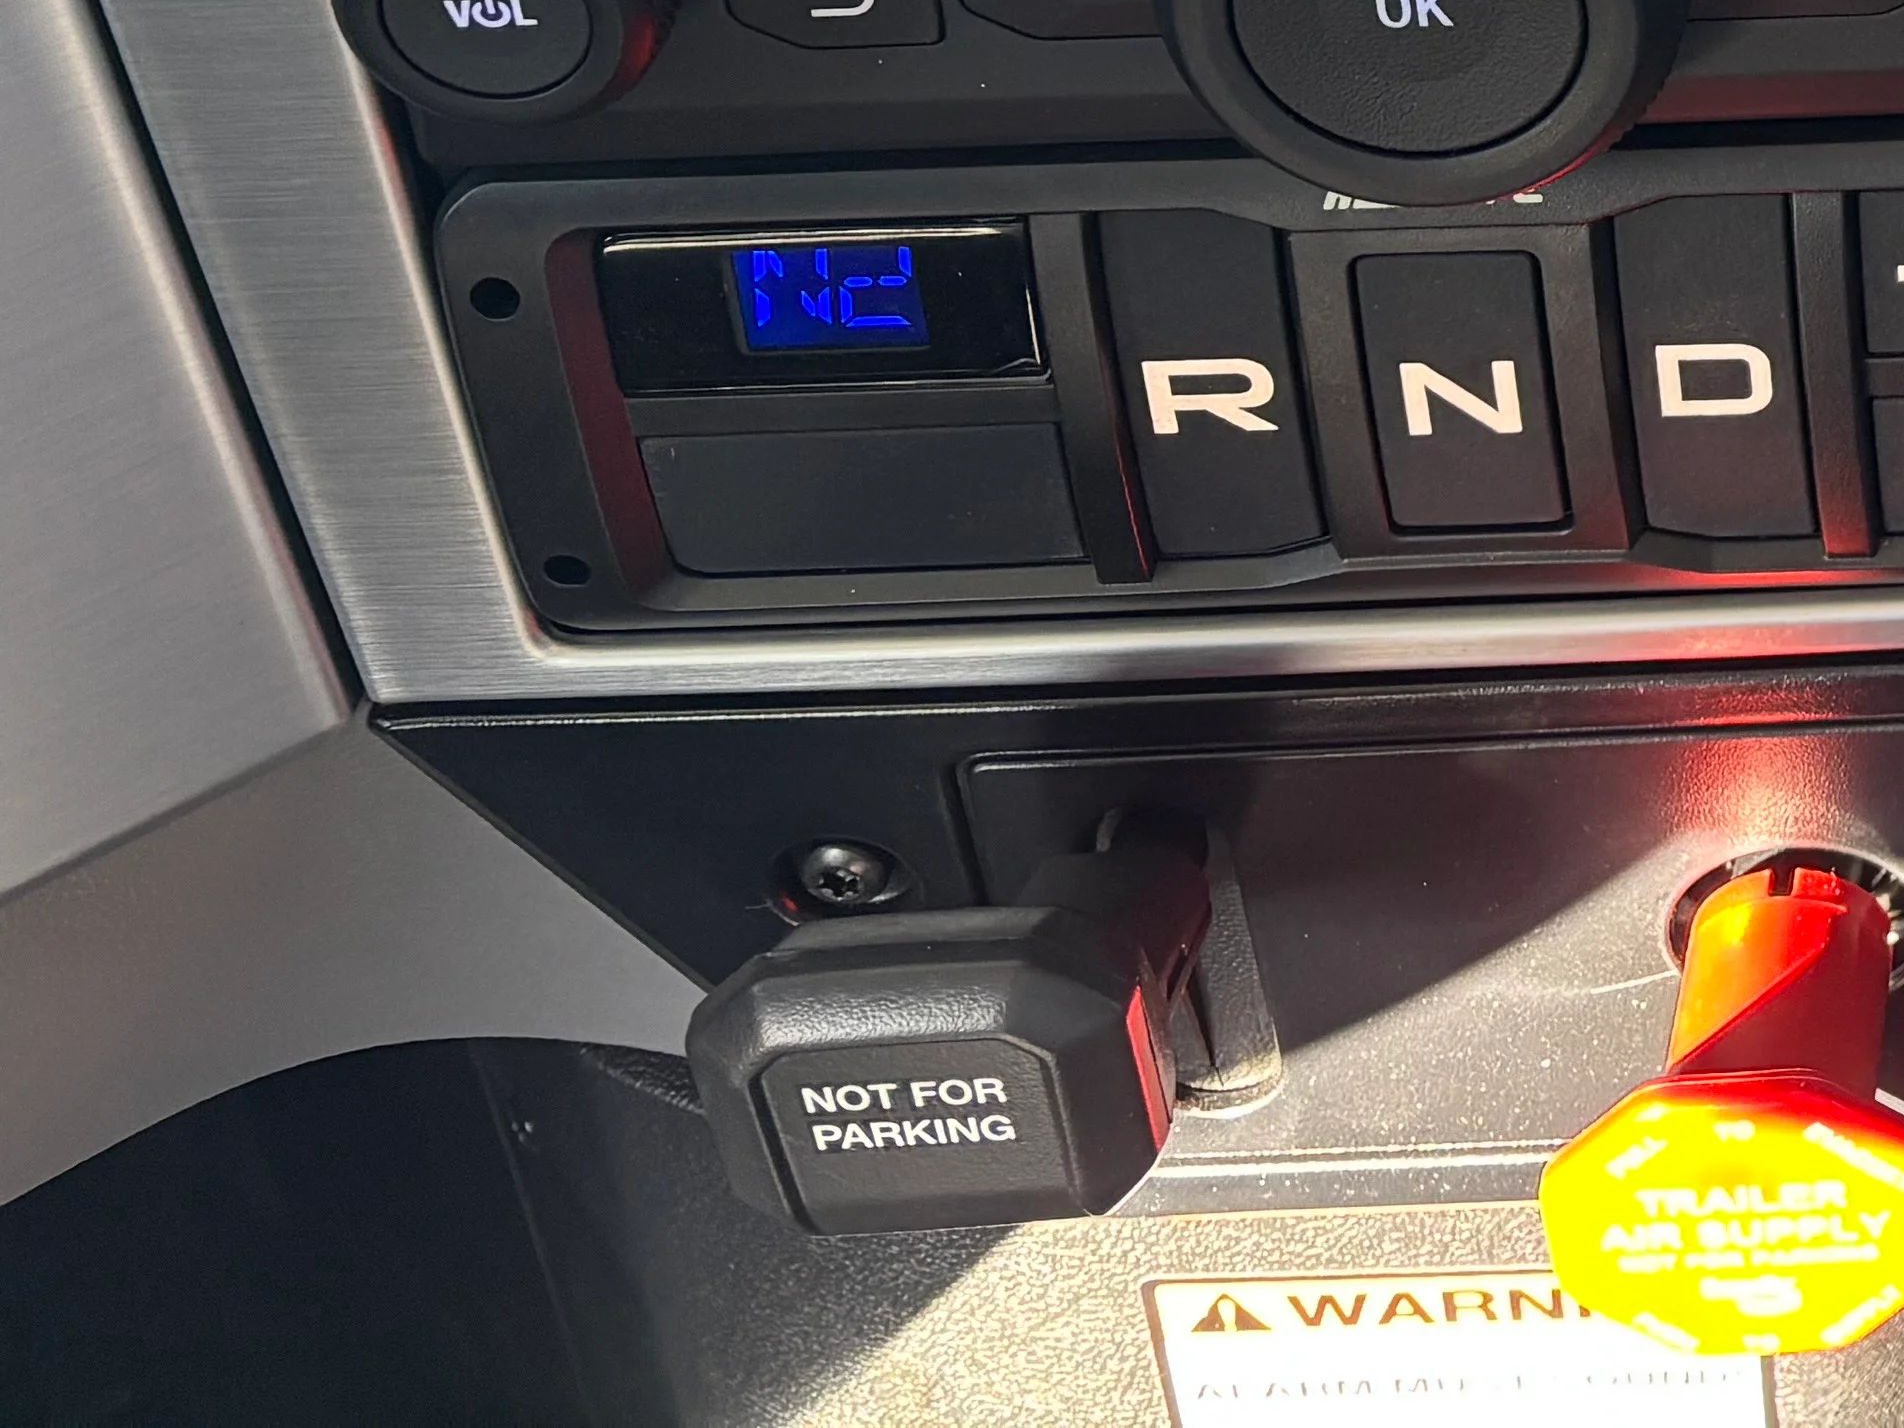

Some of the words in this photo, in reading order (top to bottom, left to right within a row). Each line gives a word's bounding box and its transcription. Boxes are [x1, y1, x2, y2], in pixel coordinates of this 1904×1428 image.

[1140, 358, 1279, 435] R
[1399, 360, 1523, 436] N
[1654, 343, 1773, 418] D
[801, 1083, 898, 1114] NOT
[910, 1077, 1008, 1108] FOR
[812, 1115, 1017, 1151] PARKING
[1634, 1180, 1847, 1218] TRAILER
[1600, 1222, 1684, 1251] AIR
[1697, 1210, 1891, 1250] SUPPLY
[1287, 1289, 1592, 1326] WARN
